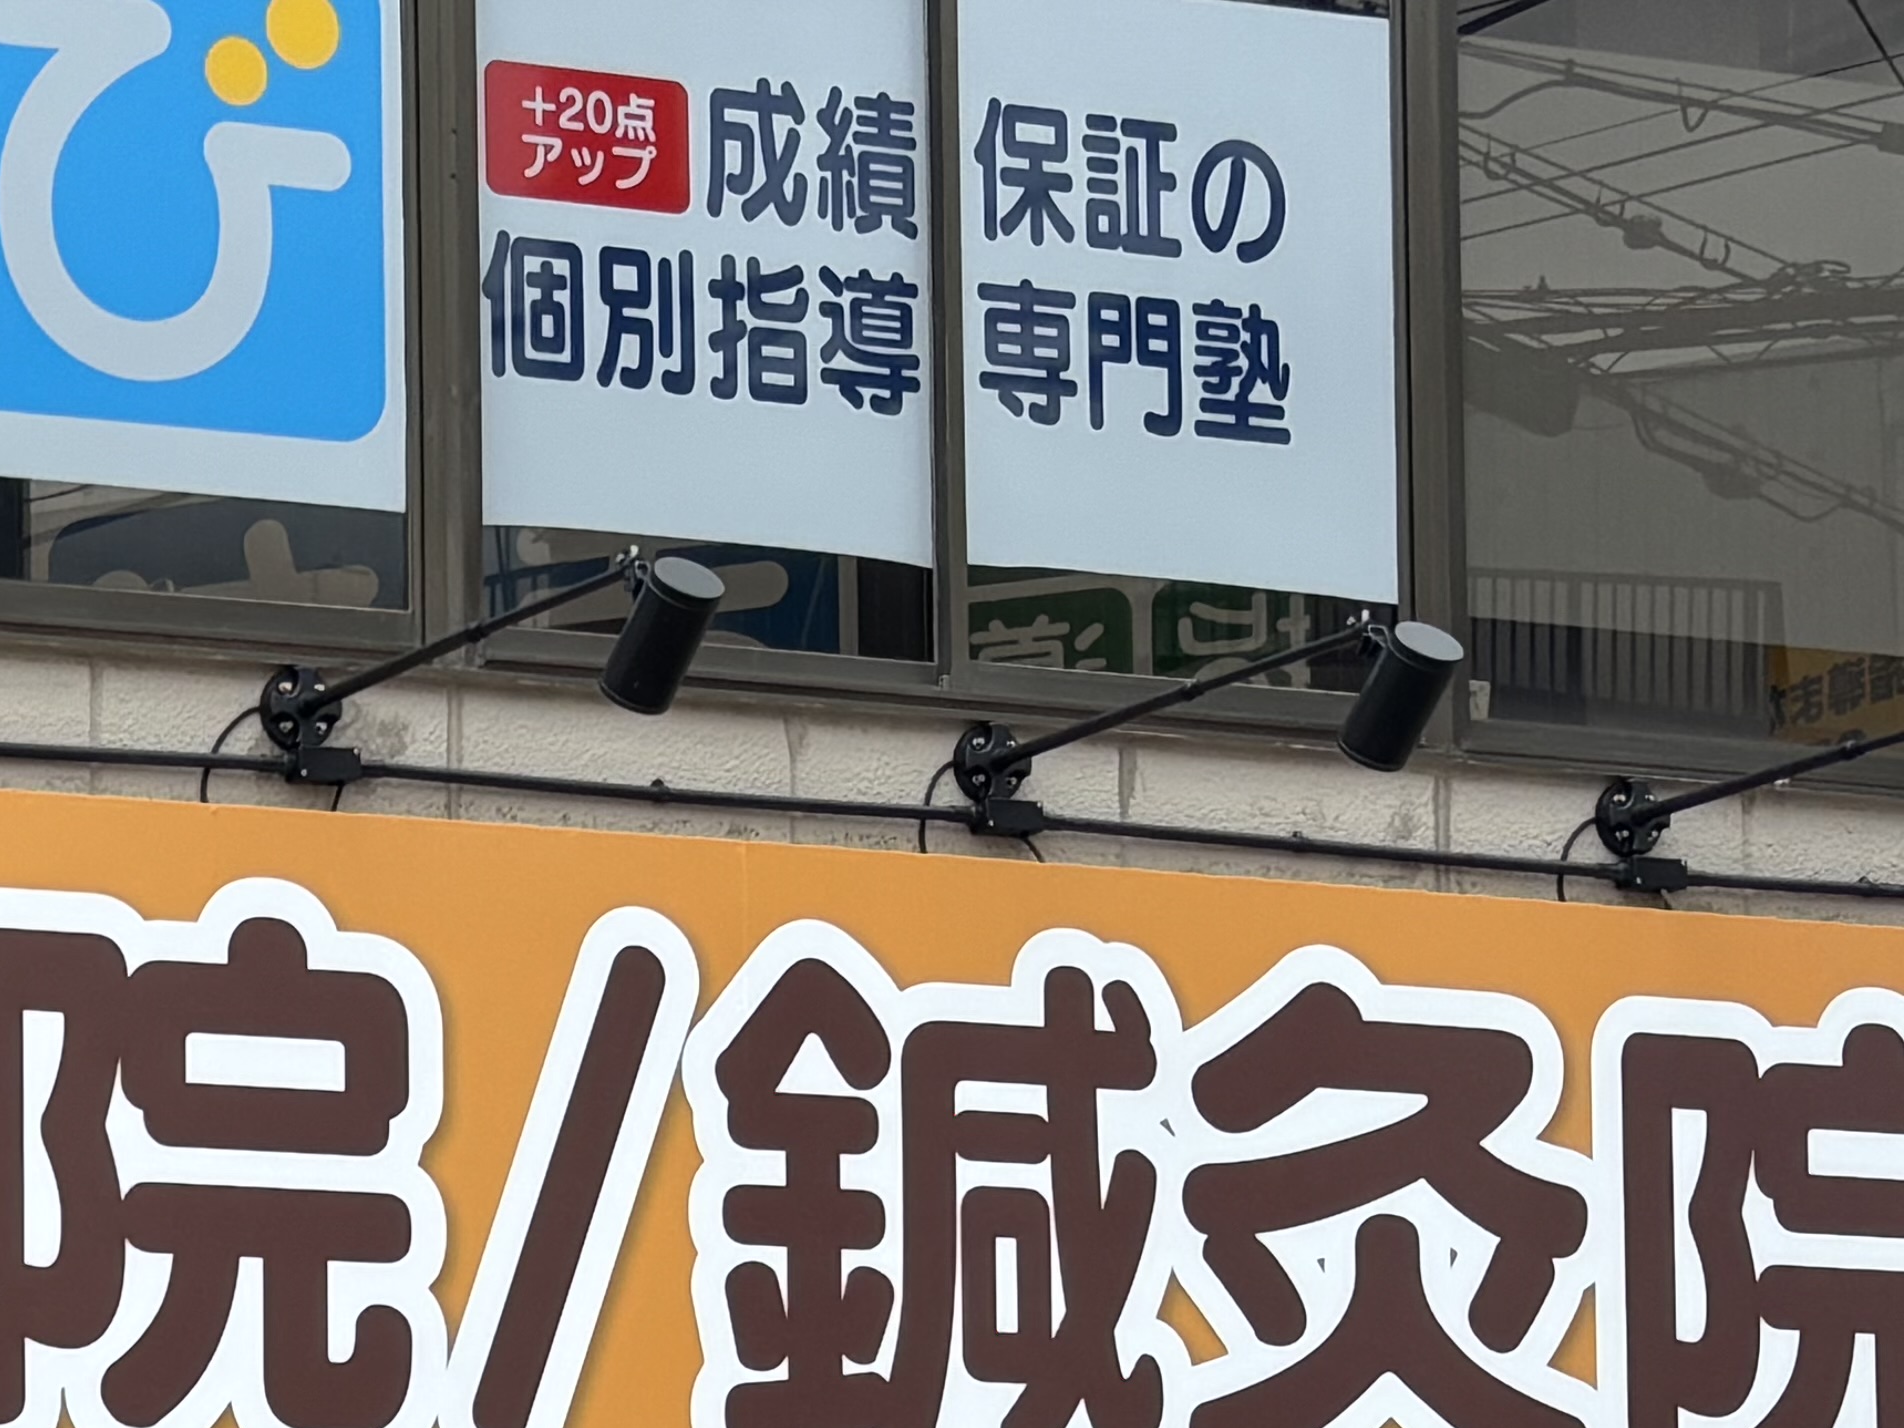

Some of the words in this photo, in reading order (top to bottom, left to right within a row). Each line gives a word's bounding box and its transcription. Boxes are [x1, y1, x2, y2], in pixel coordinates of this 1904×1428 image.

[518, 133, 658, 192] アップ
[520, 82, 656, 142] +20点
[706, 78, 918, 241] 成績
[974, 96, 1287, 264] 保証の
[480, 228, 922, 417] 個別指導
[978, 278, 1294, 447] 専門塾
